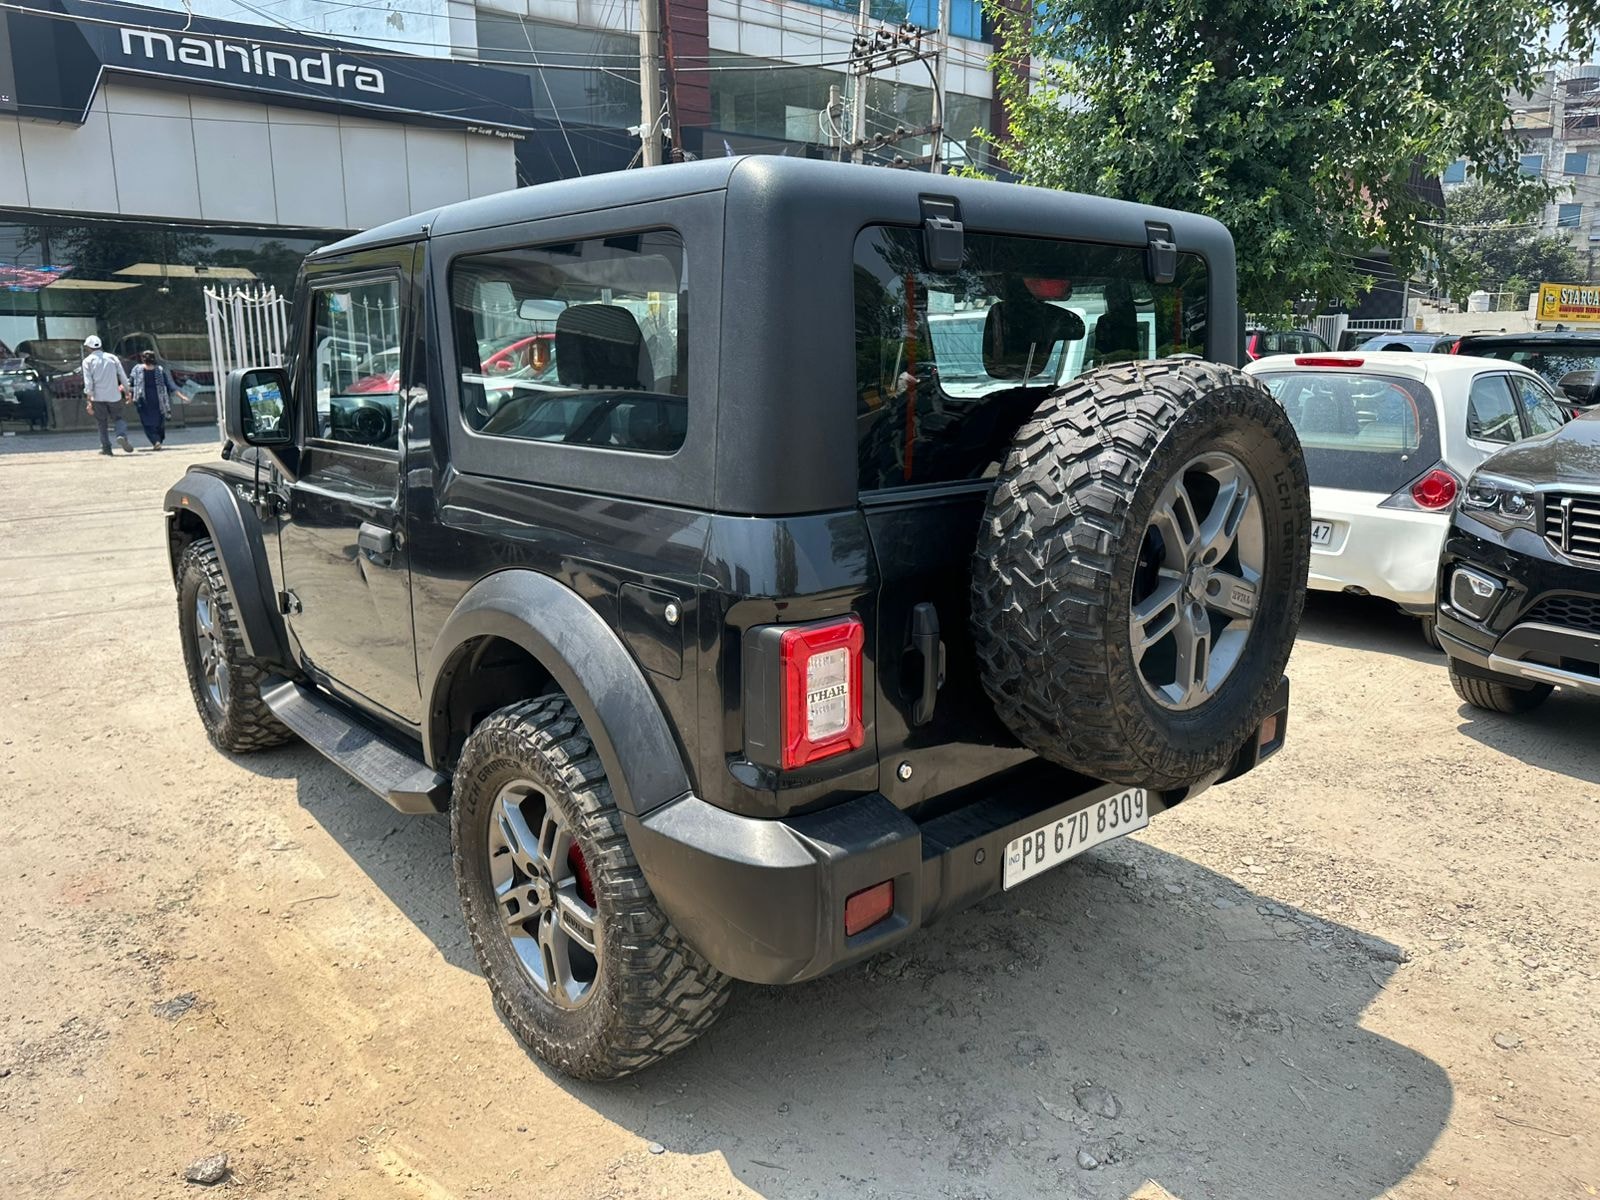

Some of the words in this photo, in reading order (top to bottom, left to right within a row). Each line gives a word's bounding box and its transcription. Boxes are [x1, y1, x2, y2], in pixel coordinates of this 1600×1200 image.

[120, 27, 385, 94] mahindra
[807, 684, 847, 704] THAR
[1022, 830, 1045, 871] PB
[1054, 811, 1089, 853] 67D
[1097, 789, 1143, 833] 8309
